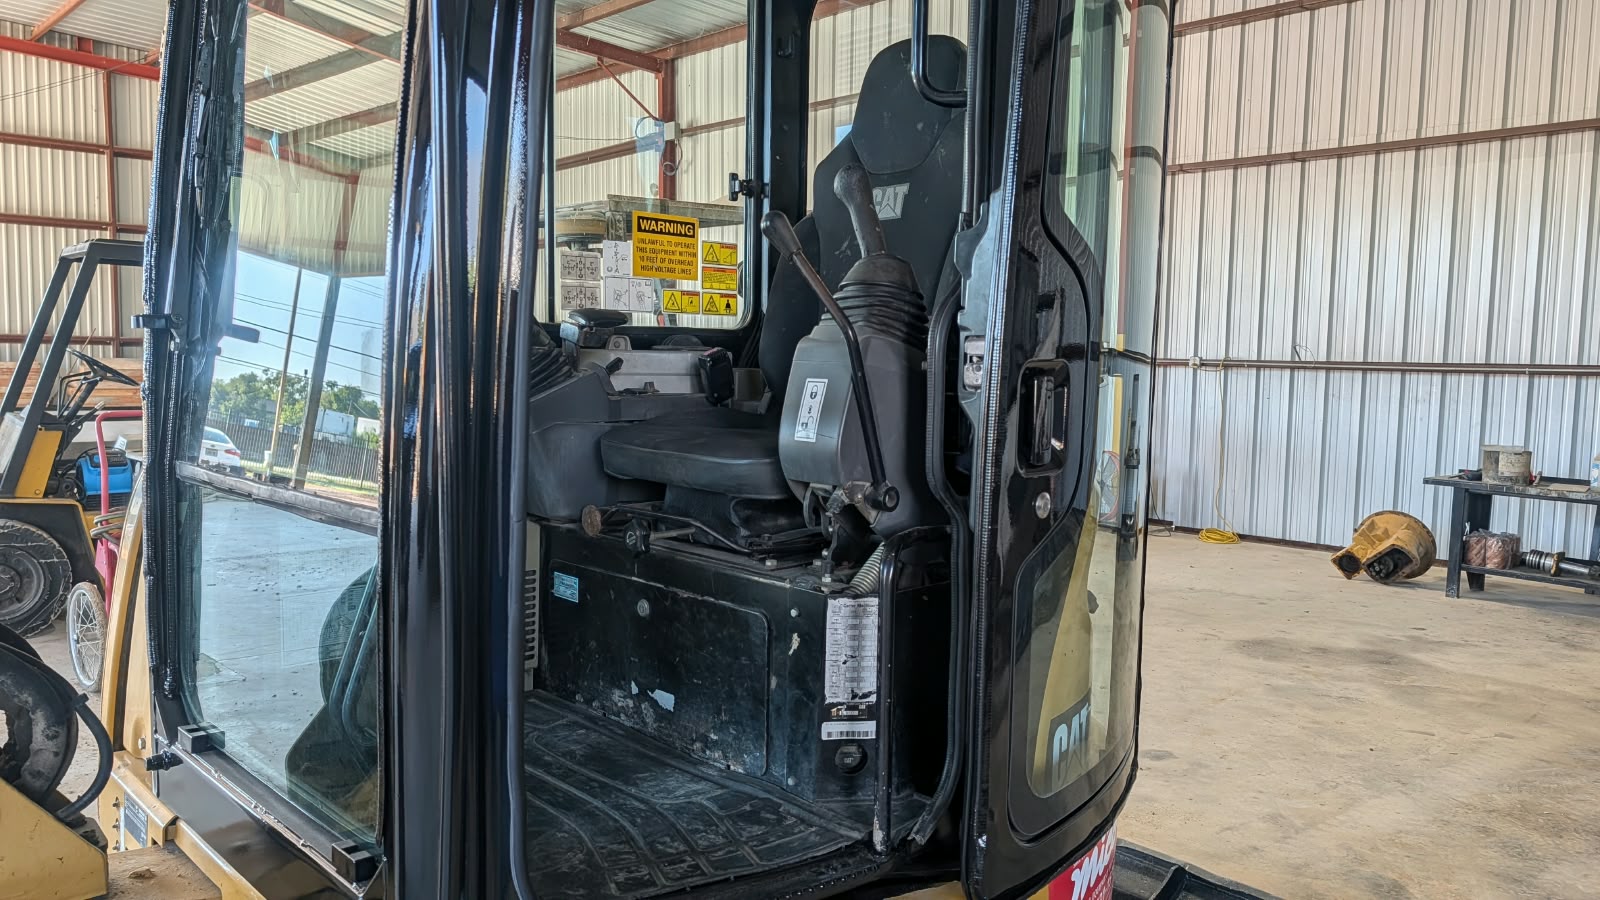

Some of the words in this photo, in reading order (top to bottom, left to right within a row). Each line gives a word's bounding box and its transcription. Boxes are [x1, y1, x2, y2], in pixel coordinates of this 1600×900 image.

[873, 184, 909, 219] CAT
[639, 219, 694, 236] WARNING
[637, 238, 665, 247] UNLAWFUL
[649, 248, 677, 256] EQUIPMENT
[655, 266, 677, 274] VOLTAGE
[1052, 703, 1091, 788] CAT
